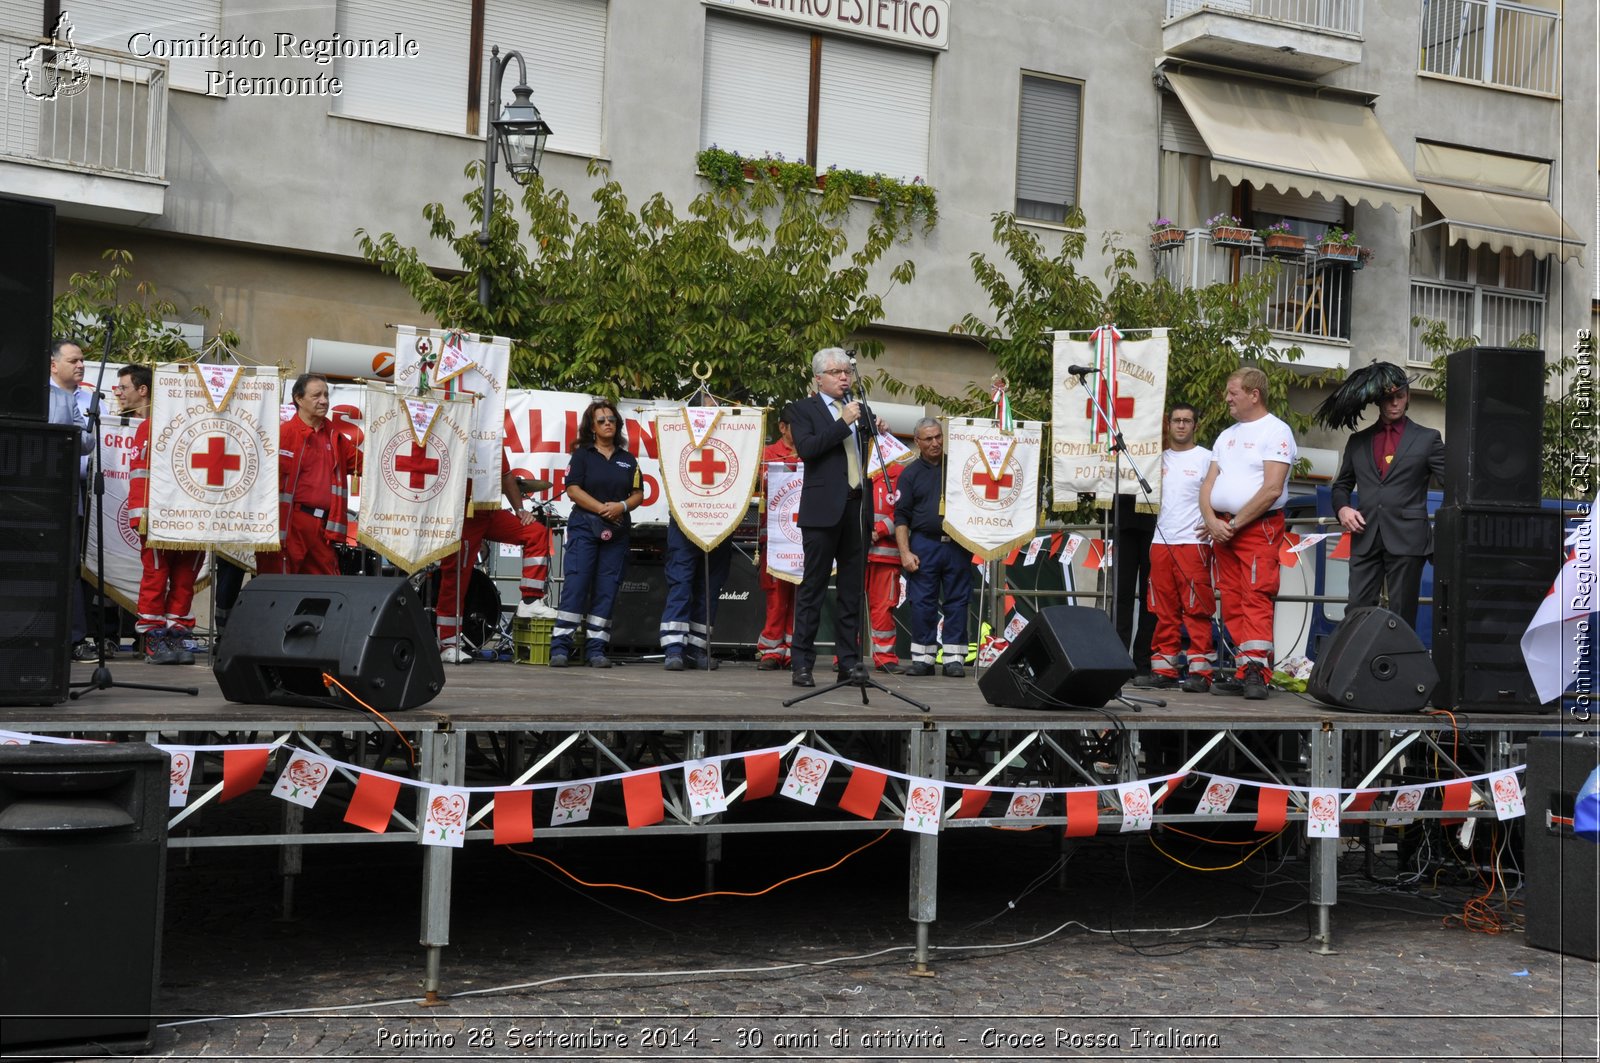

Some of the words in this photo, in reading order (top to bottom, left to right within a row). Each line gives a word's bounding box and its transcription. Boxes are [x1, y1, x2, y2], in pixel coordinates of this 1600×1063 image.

[837, 0, 939, 37] ESTETICO
[400, 361, 420, 382] CROC
[1119, 359, 1156, 387] ITALIANA
[369, 408, 398, 434] CROCE
[720, 423, 757, 432] ITALIANA
[156, 413, 186, 452] CROCE
[186, 402, 232, 418] ROSA
[234, 407, 275, 457] ITALIANA
[201, 421, 243, 439] GINEVRA
[104, 434, 134, 449] CRO
[950, 433, 975, 441] CROCE
[103, 469, 130, 480] COMITAT
[1075, 466, 1136, 481] POIRINO
[769, 486, 788, 512] CROCE
[787, 478, 804, 490] ROS
[713, 502, 738, 510] LOCALE
[159, 509, 212, 519] COMITATO
[215, 510, 254, 520] LOCALE
[257, 512, 268, 520] DI
[373, 513, 418, 523] COMITATO
[421, 514, 453, 524] LOCALE
[686, 511, 729, 519] PIOSSASCO
[151, 520, 194, 530] BORGO
[198, 521, 208, 531] S.
[212, 522, 274, 533] DALMAZZO
[967, 516, 1014, 528] AIRASCA
[366, 526, 410, 536] SETTIMO
[414, 528, 458, 539] TORINESE
[1466, 514, 1554, 550] EUROPE
[718, 588, 750, 601] arshall
